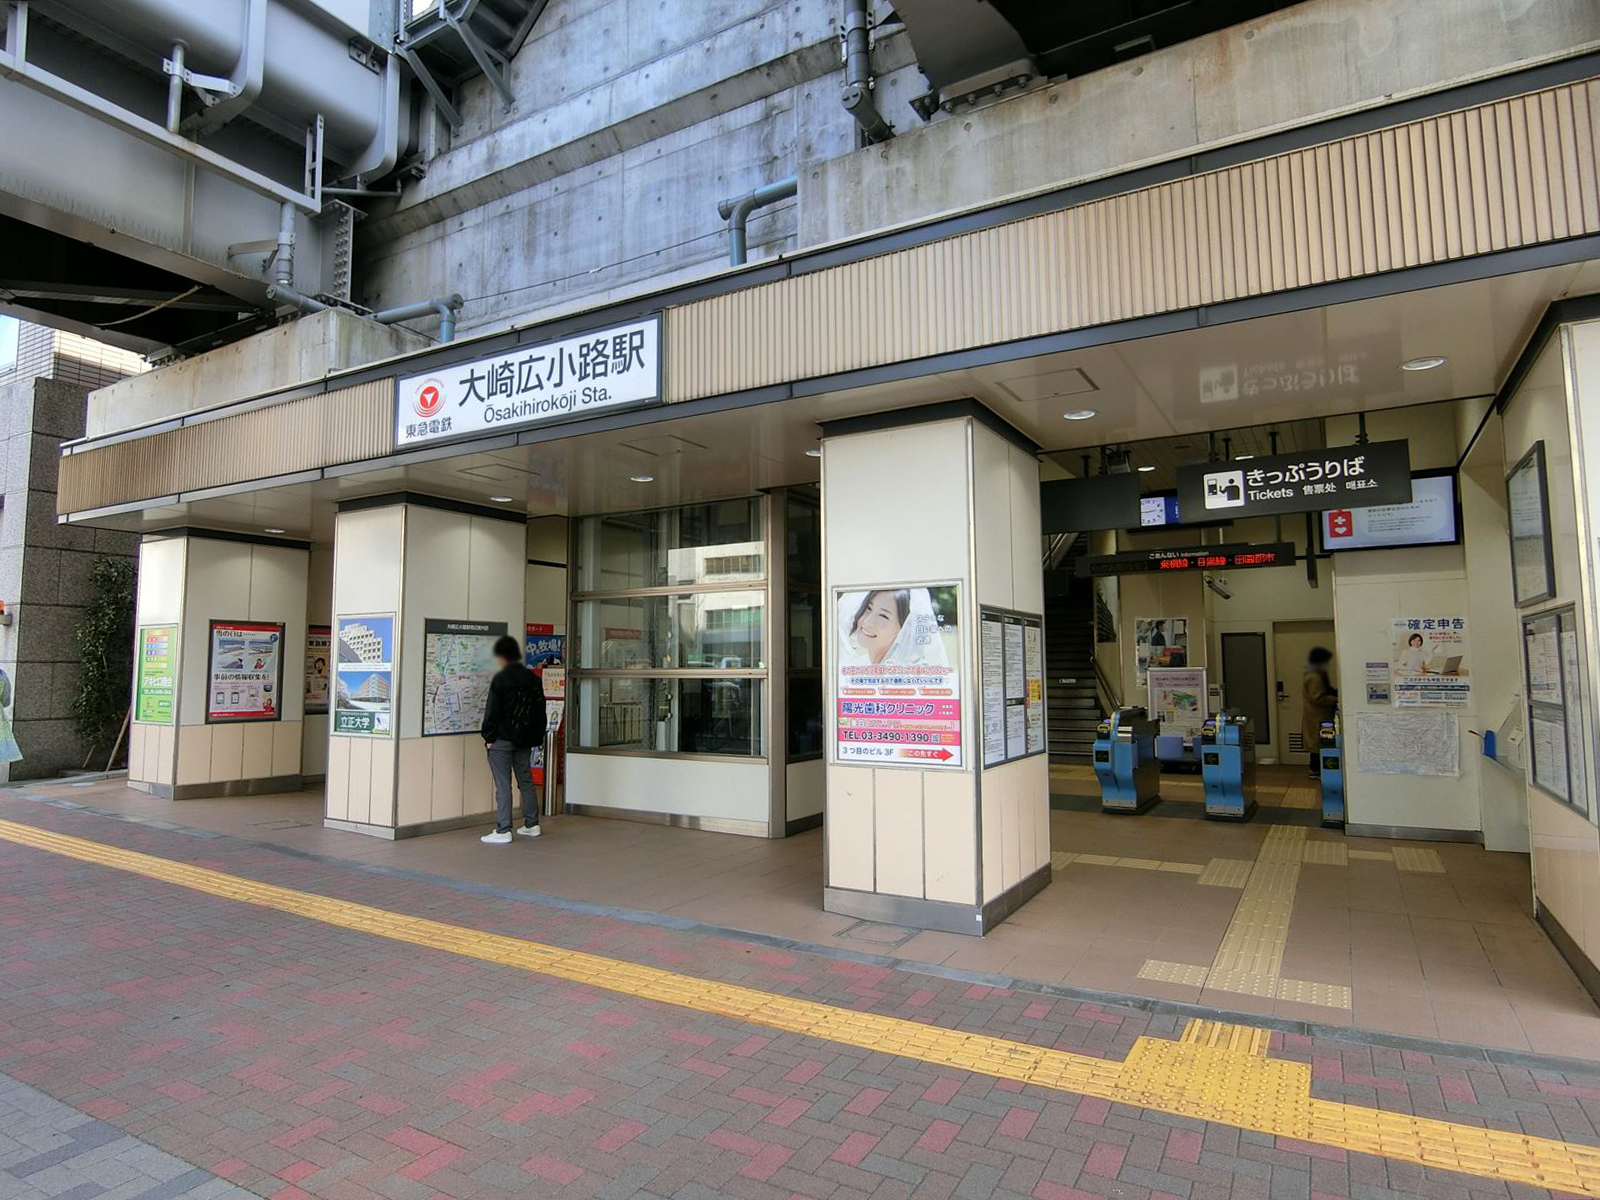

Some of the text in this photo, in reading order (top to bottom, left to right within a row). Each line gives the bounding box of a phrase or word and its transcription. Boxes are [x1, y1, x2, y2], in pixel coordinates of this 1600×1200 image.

[458, 329, 646, 408] 大崎広小路駅
[581, 386, 612, 405] Sta.
[405, 416, 452, 439] 東急電鉄
[1246, 456, 1366, 488] きっぷうりば
[1247, 486, 1295, 502] Tickets
[1345, 479, 1379, 491] 매표소
[1149, 552, 1180, 560] ごあんない
[1407, 618, 1466, 630] 確定申告
[842, 702, 935, 716] 陽光歯科クリニック
[341, 716, 370, 729] 立正大学
[843, 730, 930, 743] TEL.03-3490-1390
[842, 746, 895, 757] 3つ目のビル 3F
